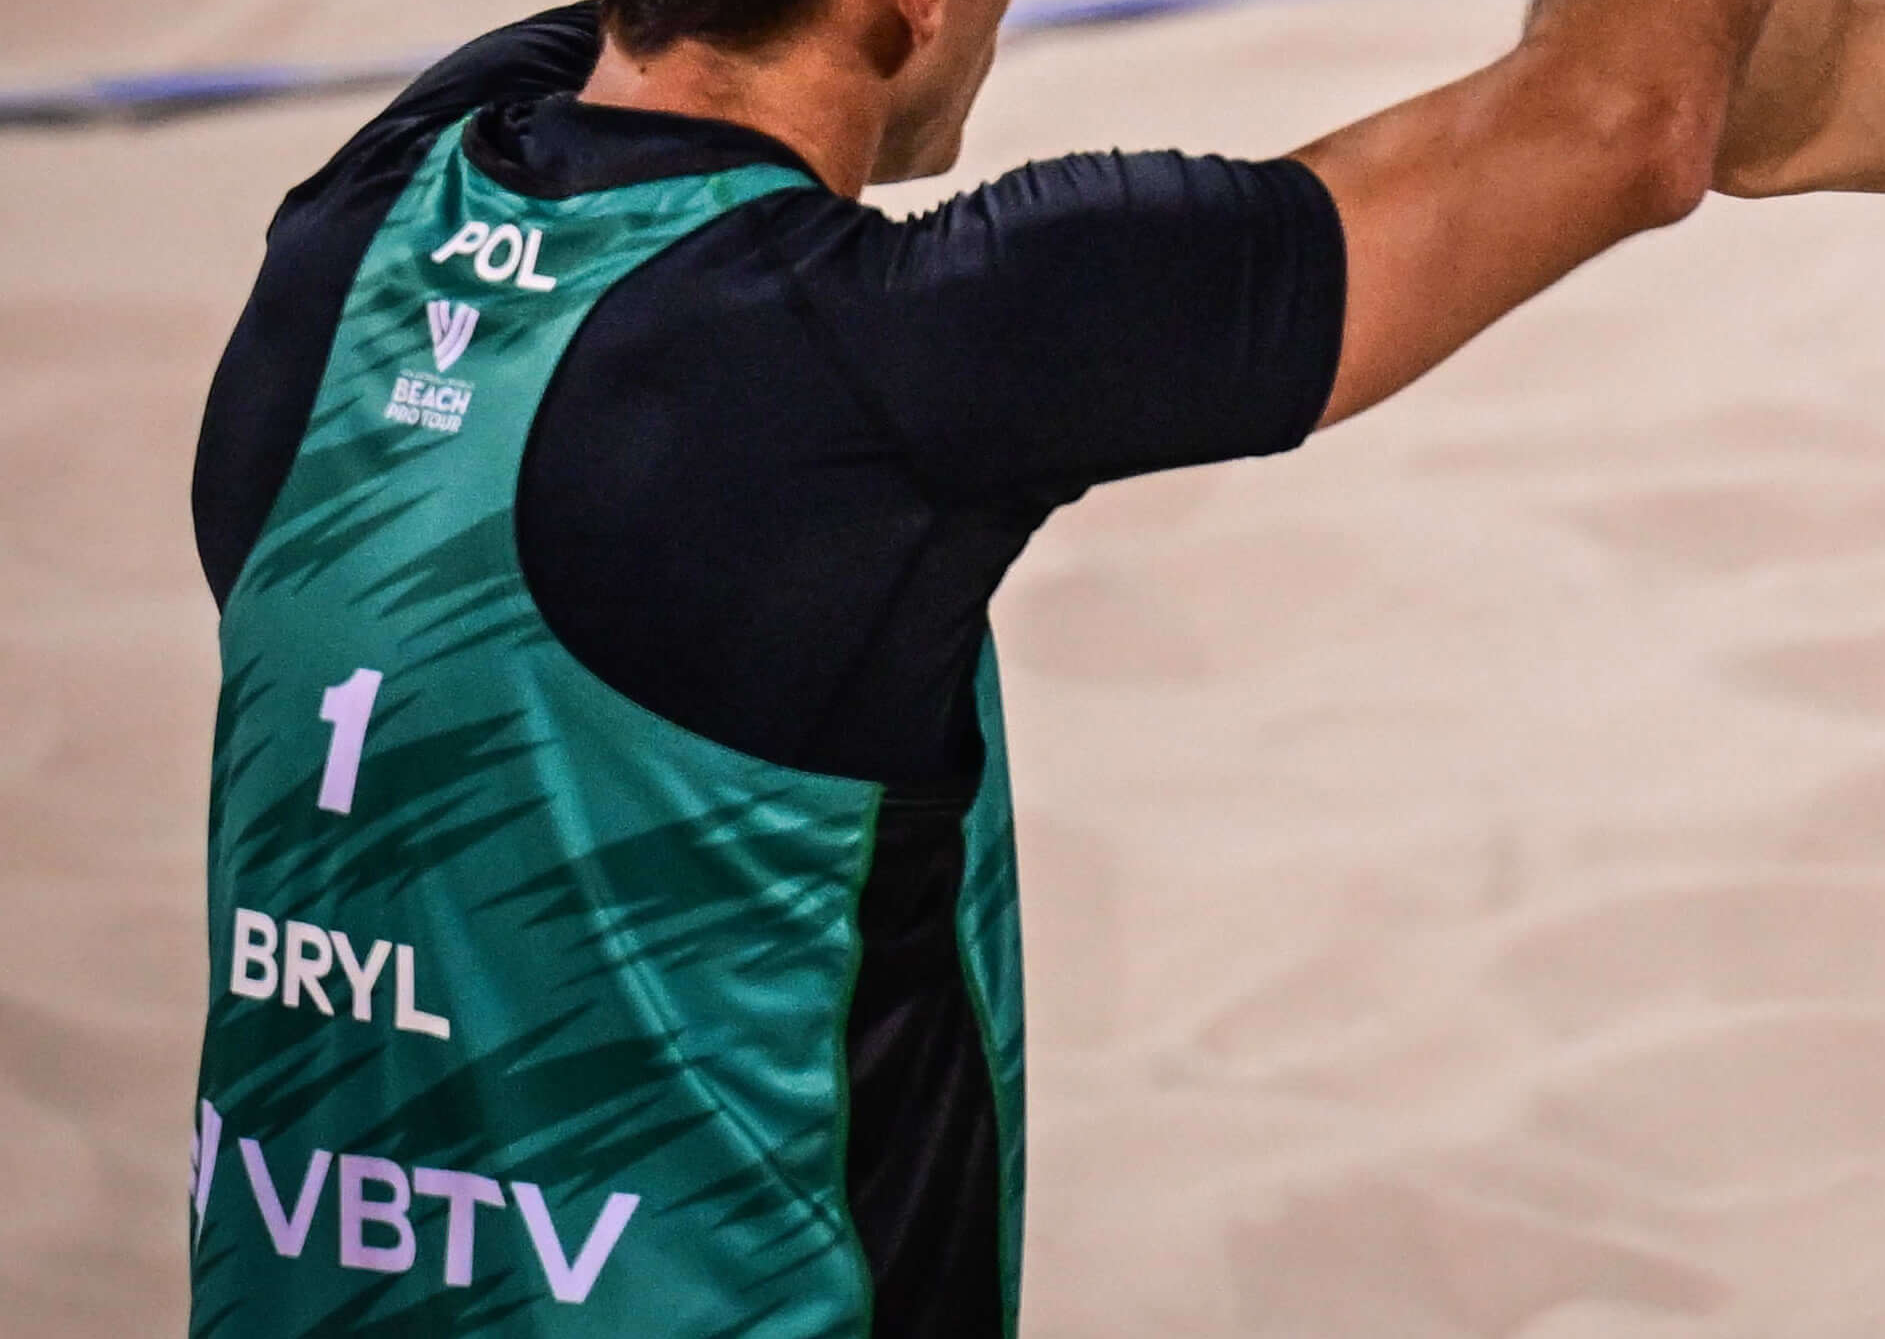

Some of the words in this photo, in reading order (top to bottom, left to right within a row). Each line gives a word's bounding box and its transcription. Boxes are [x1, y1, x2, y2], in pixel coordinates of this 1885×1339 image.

[431, 220, 558, 292] POL
[392, 376, 473, 415] BEACH
[316, 667, 383, 815] 1
[230, 907, 451, 1040] BRYL
[238, 1136, 641, 1305] VBTV
